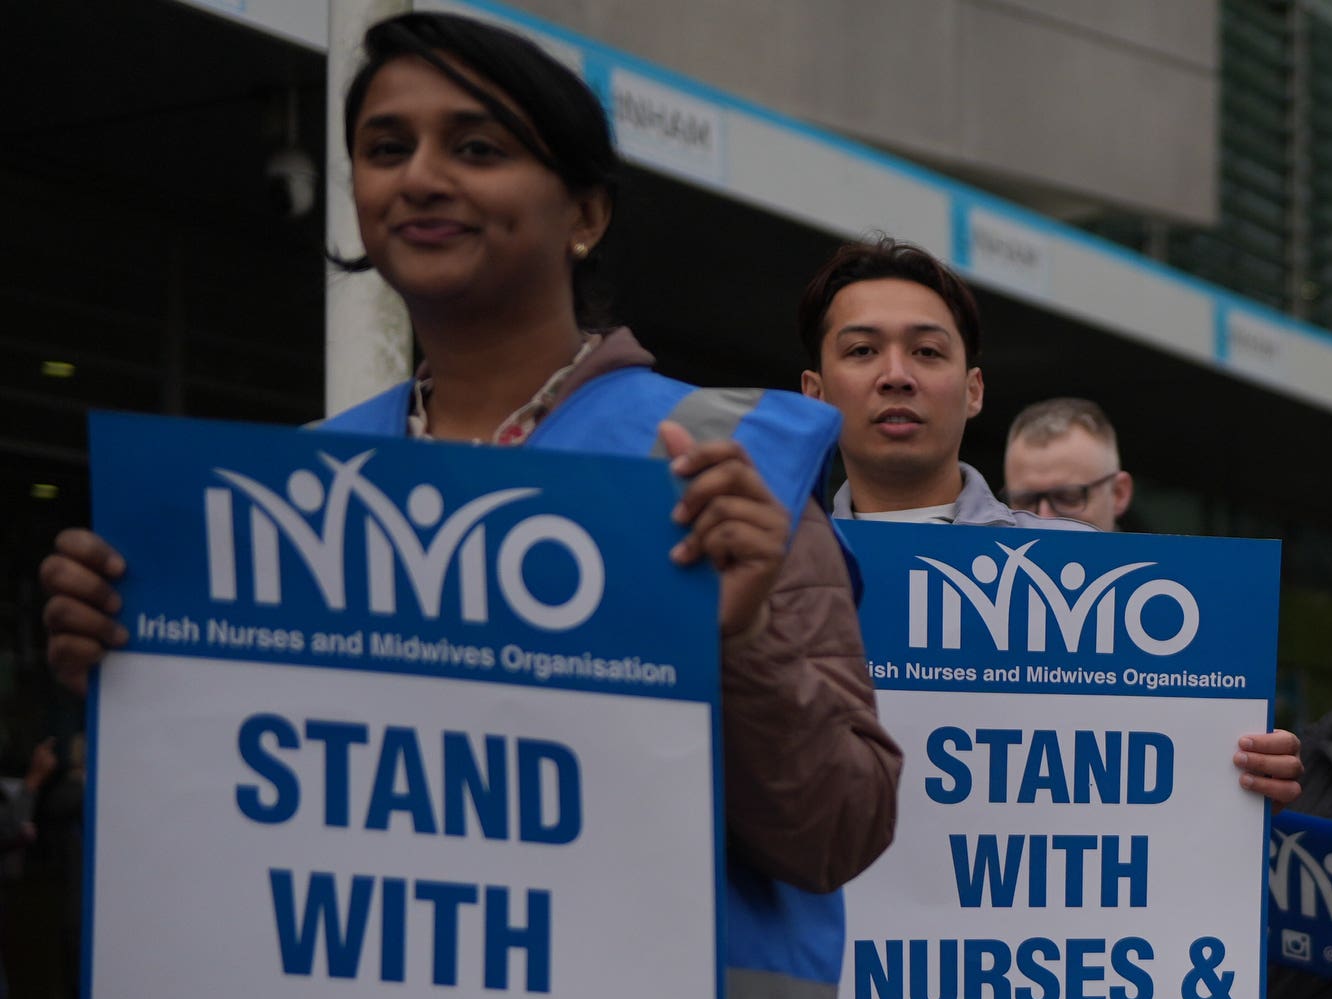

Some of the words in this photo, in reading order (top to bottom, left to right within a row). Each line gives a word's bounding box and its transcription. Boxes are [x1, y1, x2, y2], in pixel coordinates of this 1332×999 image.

[205, 448, 606, 632] INMO
[908, 539, 1200, 656] INMO
[137, 613, 200, 642] Irish
[206, 618, 305, 650] Nurses
[311, 630, 364, 656] and
[369, 632, 496, 669] Midwives
[500, 645, 677, 686] Organisation
[865, 660, 899, 679] ish
[905, 662, 977, 682] Nurses
[982, 665, 1020, 683] and
[1026, 665, 1117, 685] Midwives
[1122, 668, 1246, 690] Organisation
[235, 712, 583, 846] STAND
[924, 725, 1175, 805] STAND
[948, 833, 1149, 908] WITH
[268, 867, 552, 994] WITH
